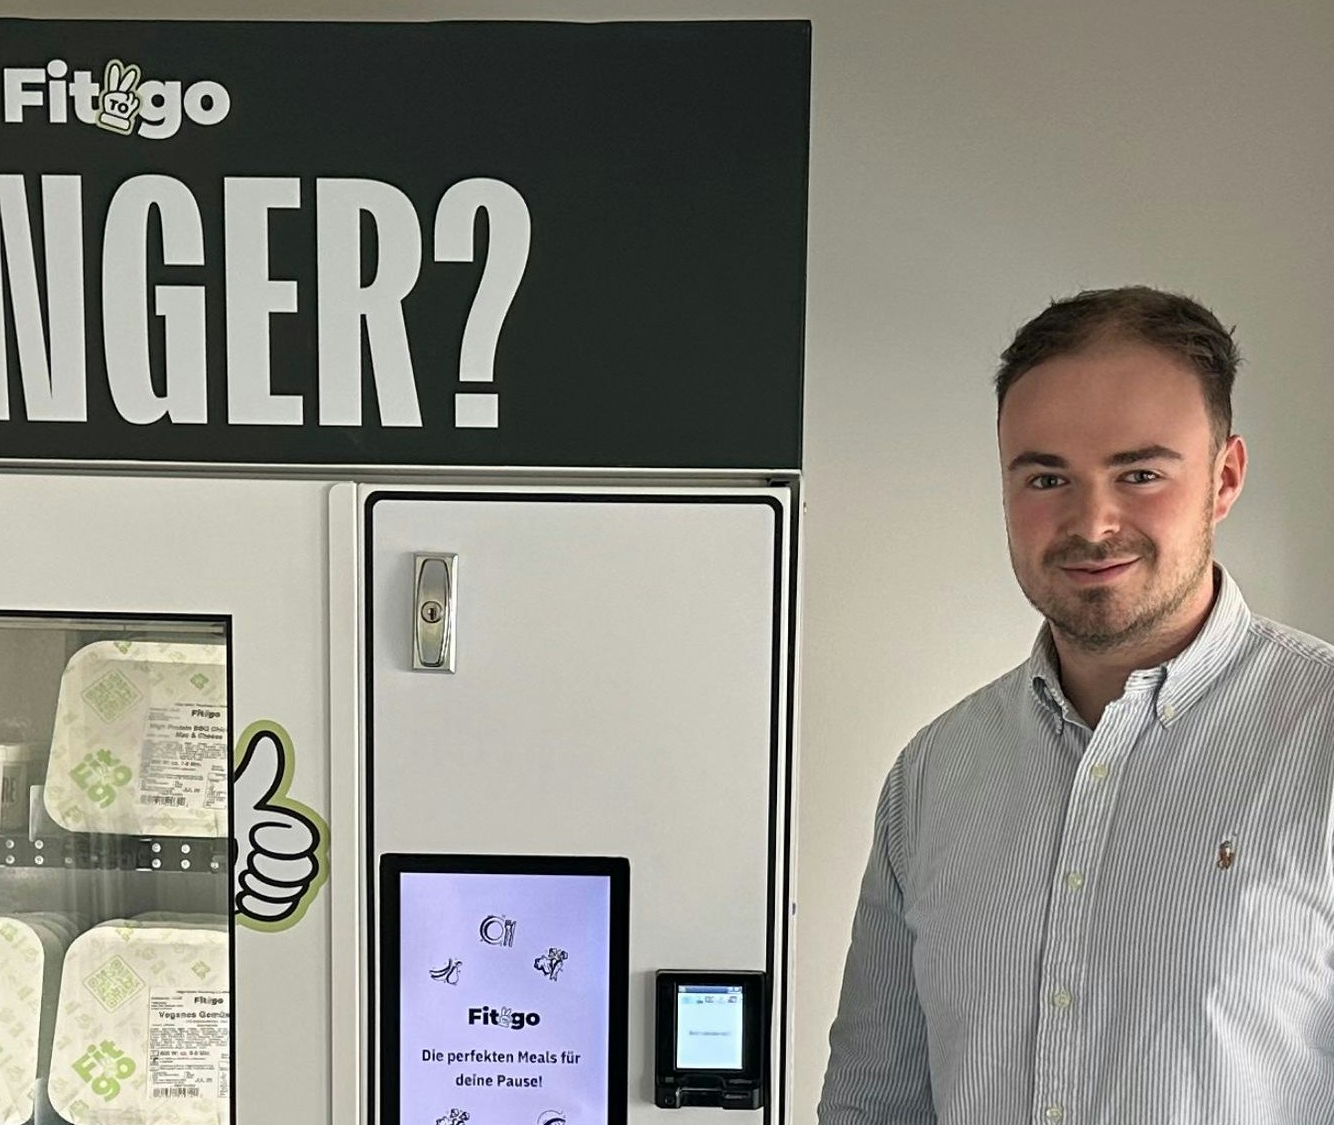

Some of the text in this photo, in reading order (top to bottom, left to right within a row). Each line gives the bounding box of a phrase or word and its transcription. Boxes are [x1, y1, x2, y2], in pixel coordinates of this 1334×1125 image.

[421, 1049, 582, 1068] Die perfekten Meals für
[455, 1073, 543, 1089] deine Pause!
